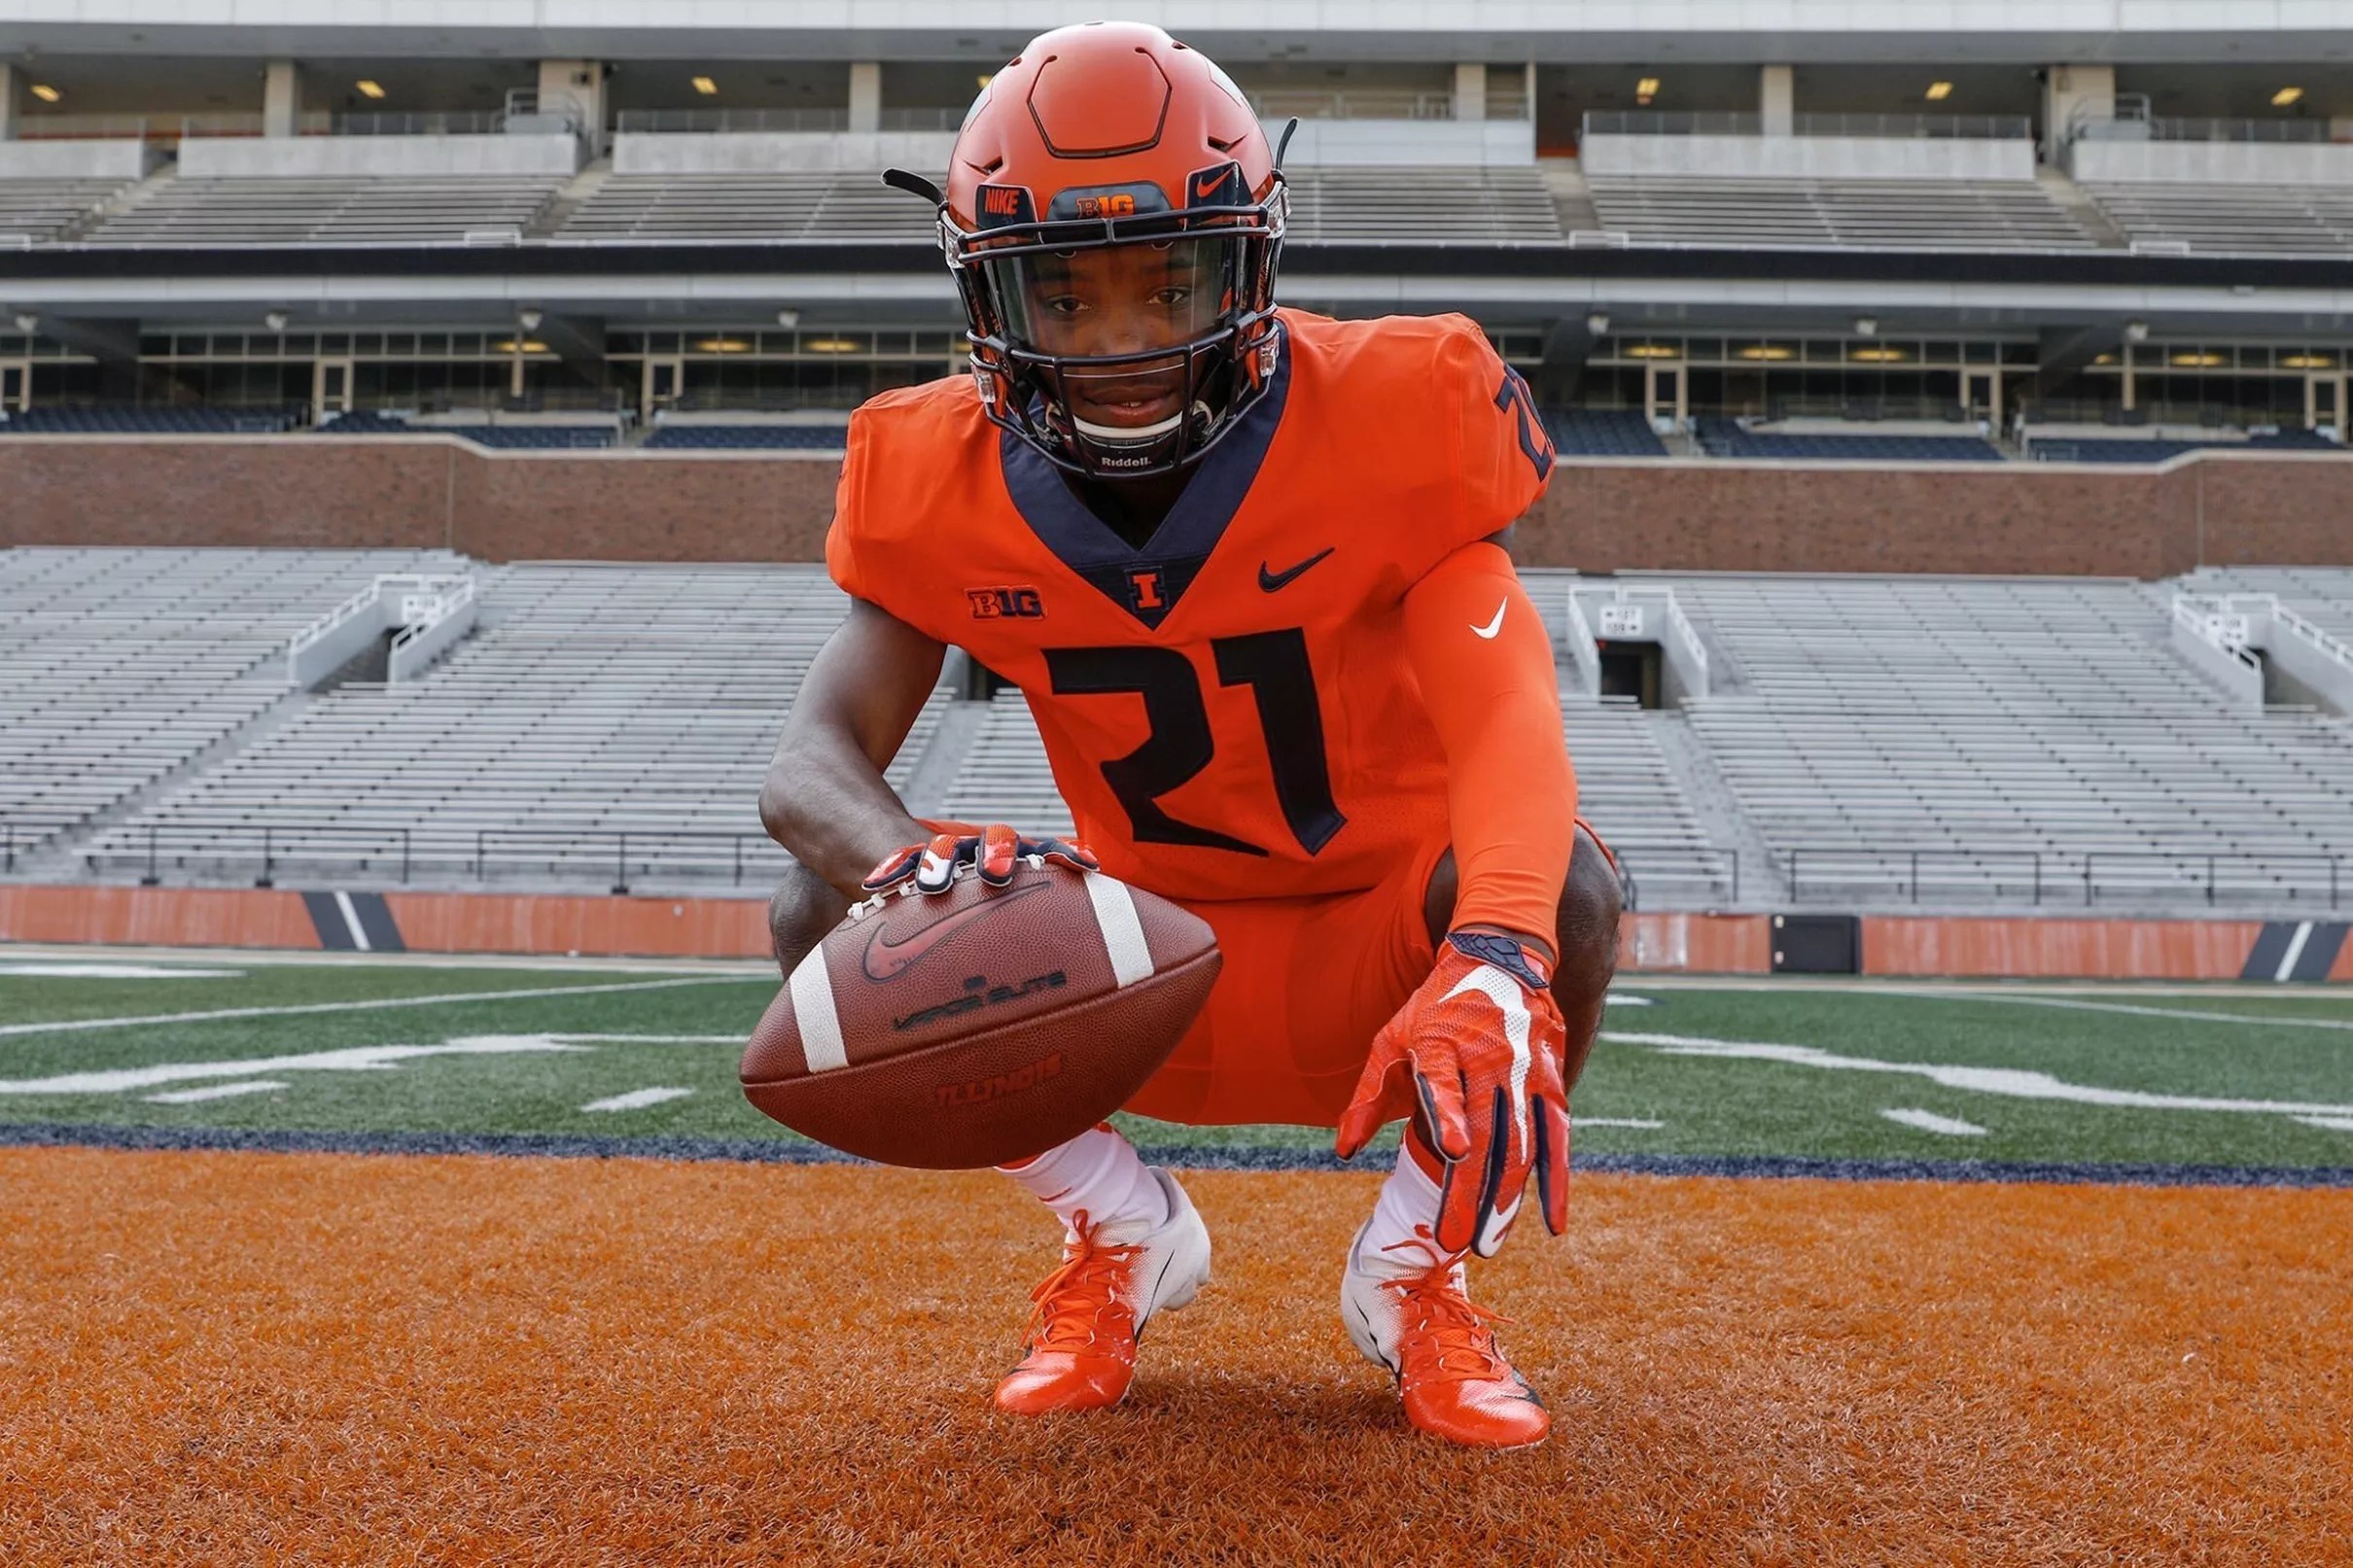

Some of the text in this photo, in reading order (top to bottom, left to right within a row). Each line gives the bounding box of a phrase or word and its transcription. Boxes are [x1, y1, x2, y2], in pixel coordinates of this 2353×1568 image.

[984, 188, 1019, 215] NIKE
[1102, 457, 1148, 468] Riddell
[1042, 627, 1349, 857] 21
